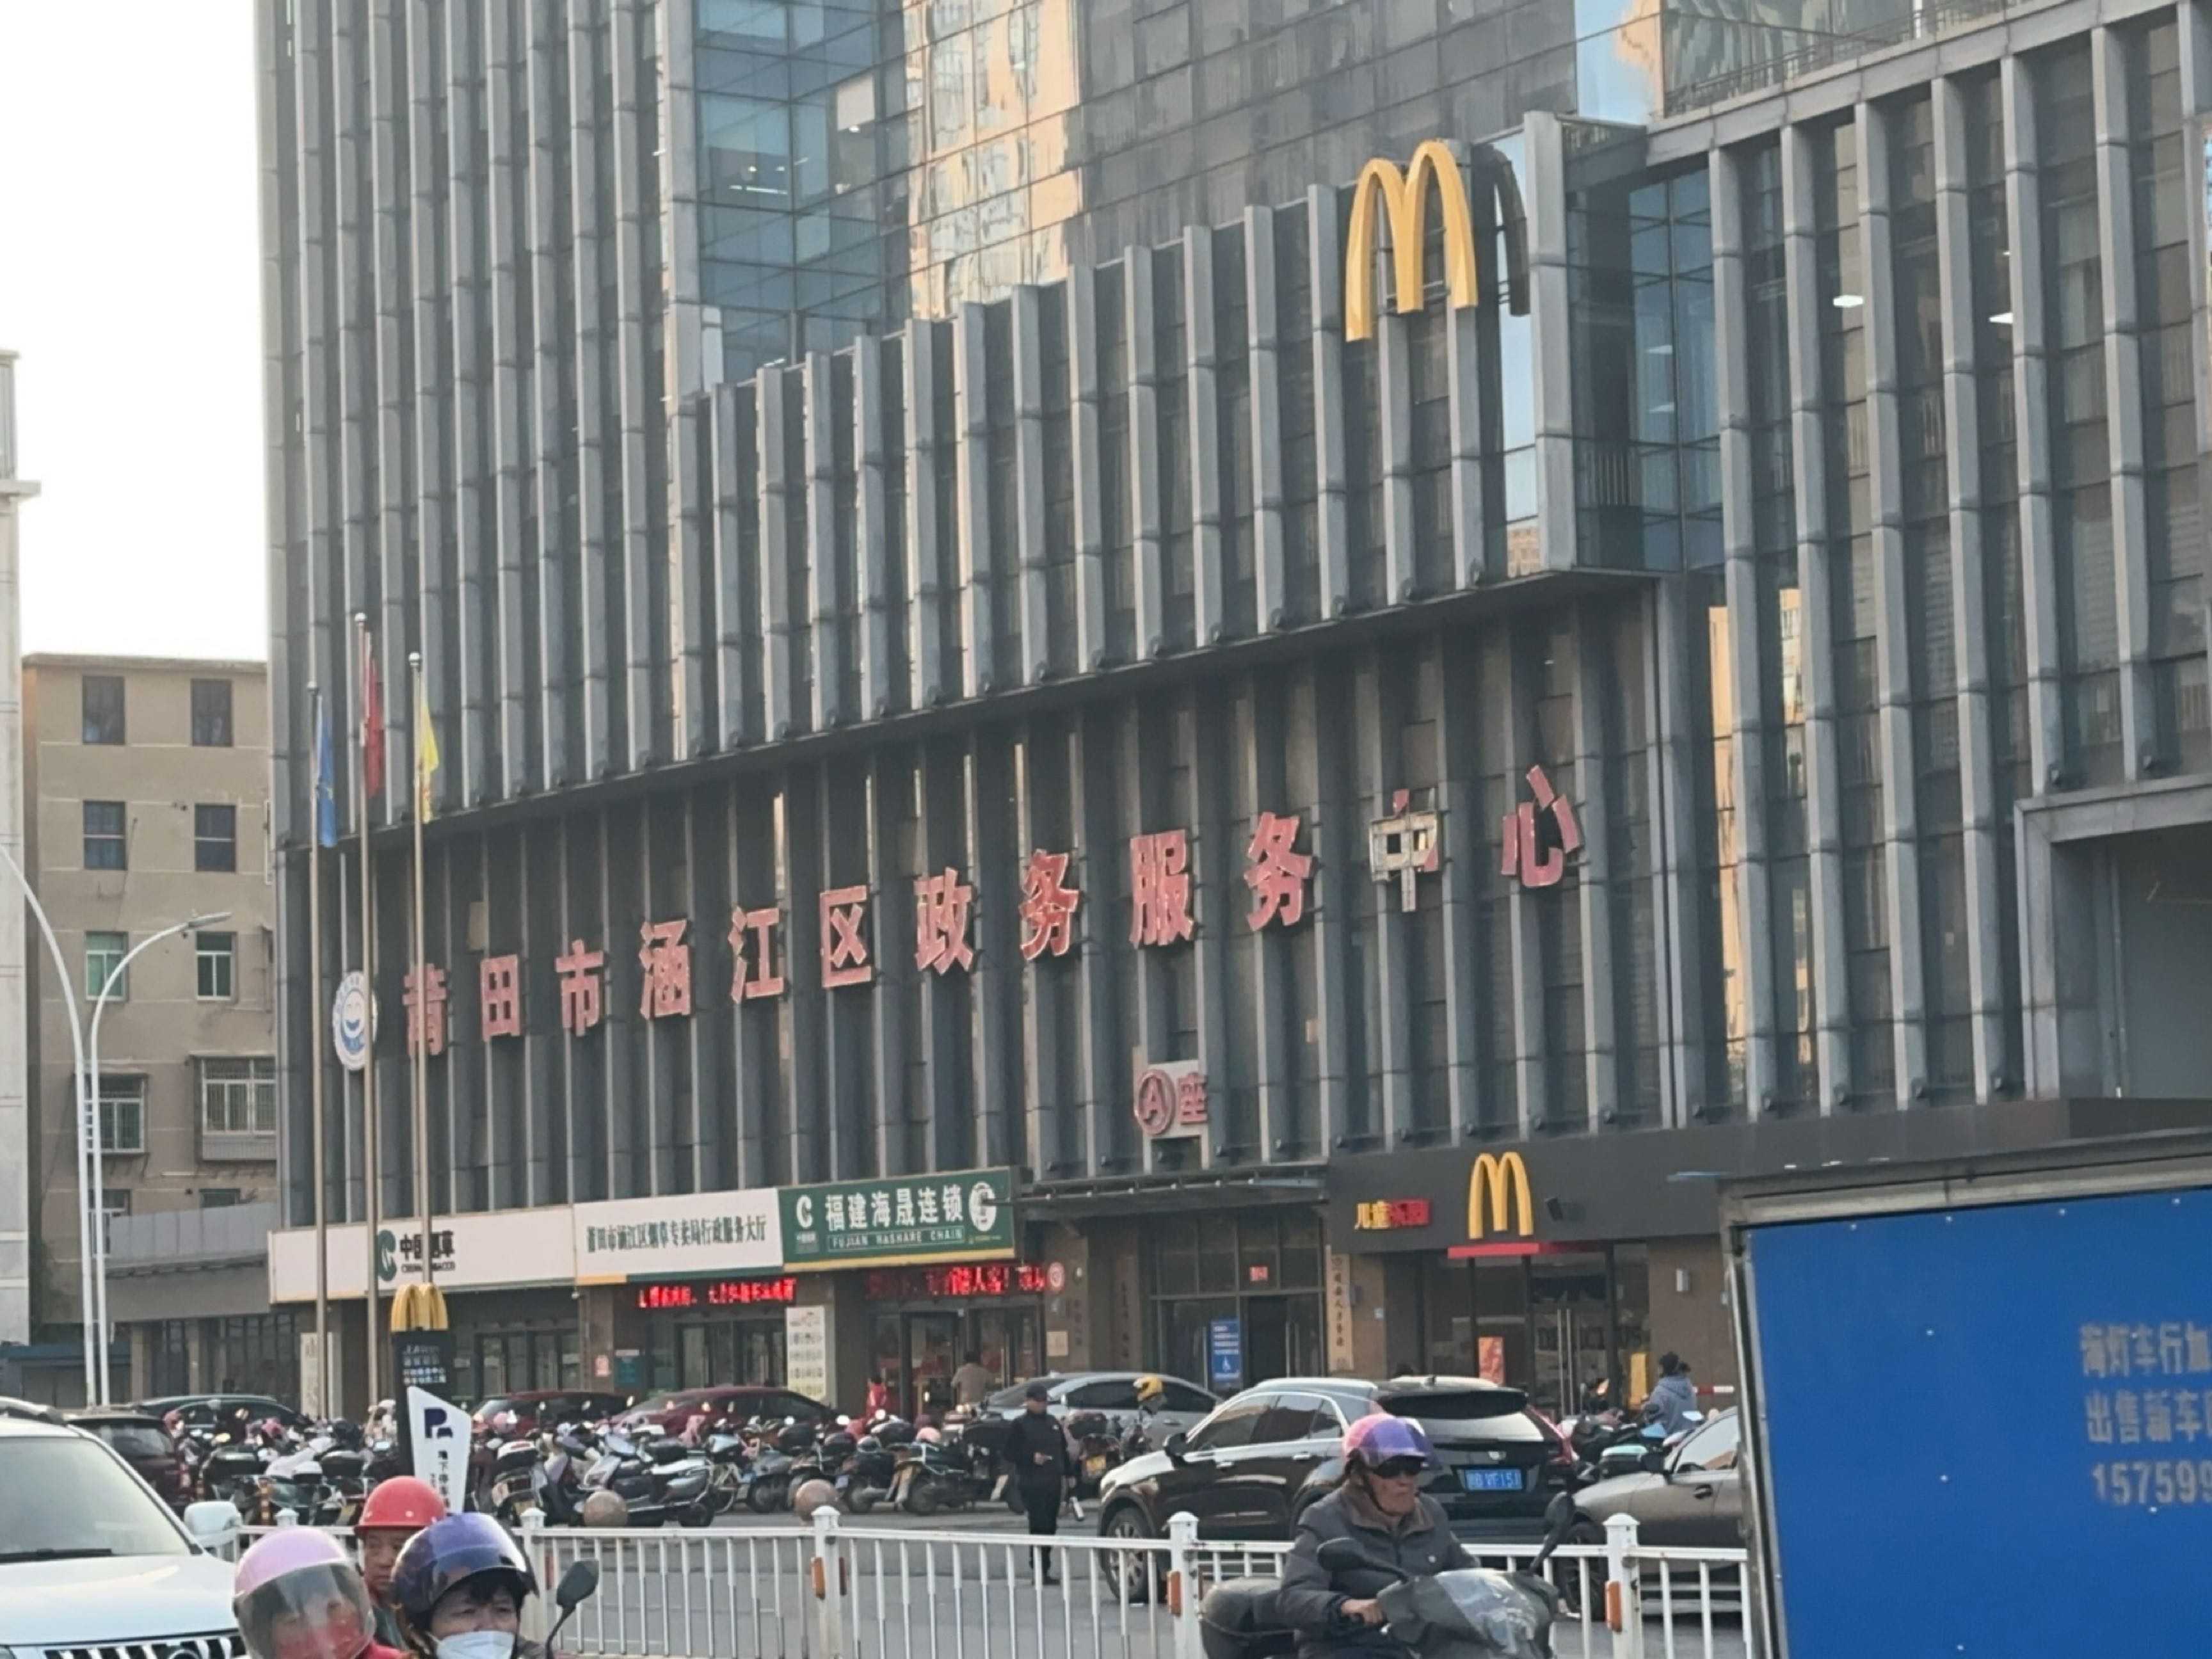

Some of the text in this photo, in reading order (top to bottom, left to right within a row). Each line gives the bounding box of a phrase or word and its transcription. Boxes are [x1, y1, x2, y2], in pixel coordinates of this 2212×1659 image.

[403, 765, 1582, 1057] 莆田市涵江区政务服务中心
[825, 1184, 963, 1232] 福建海晟连锁
